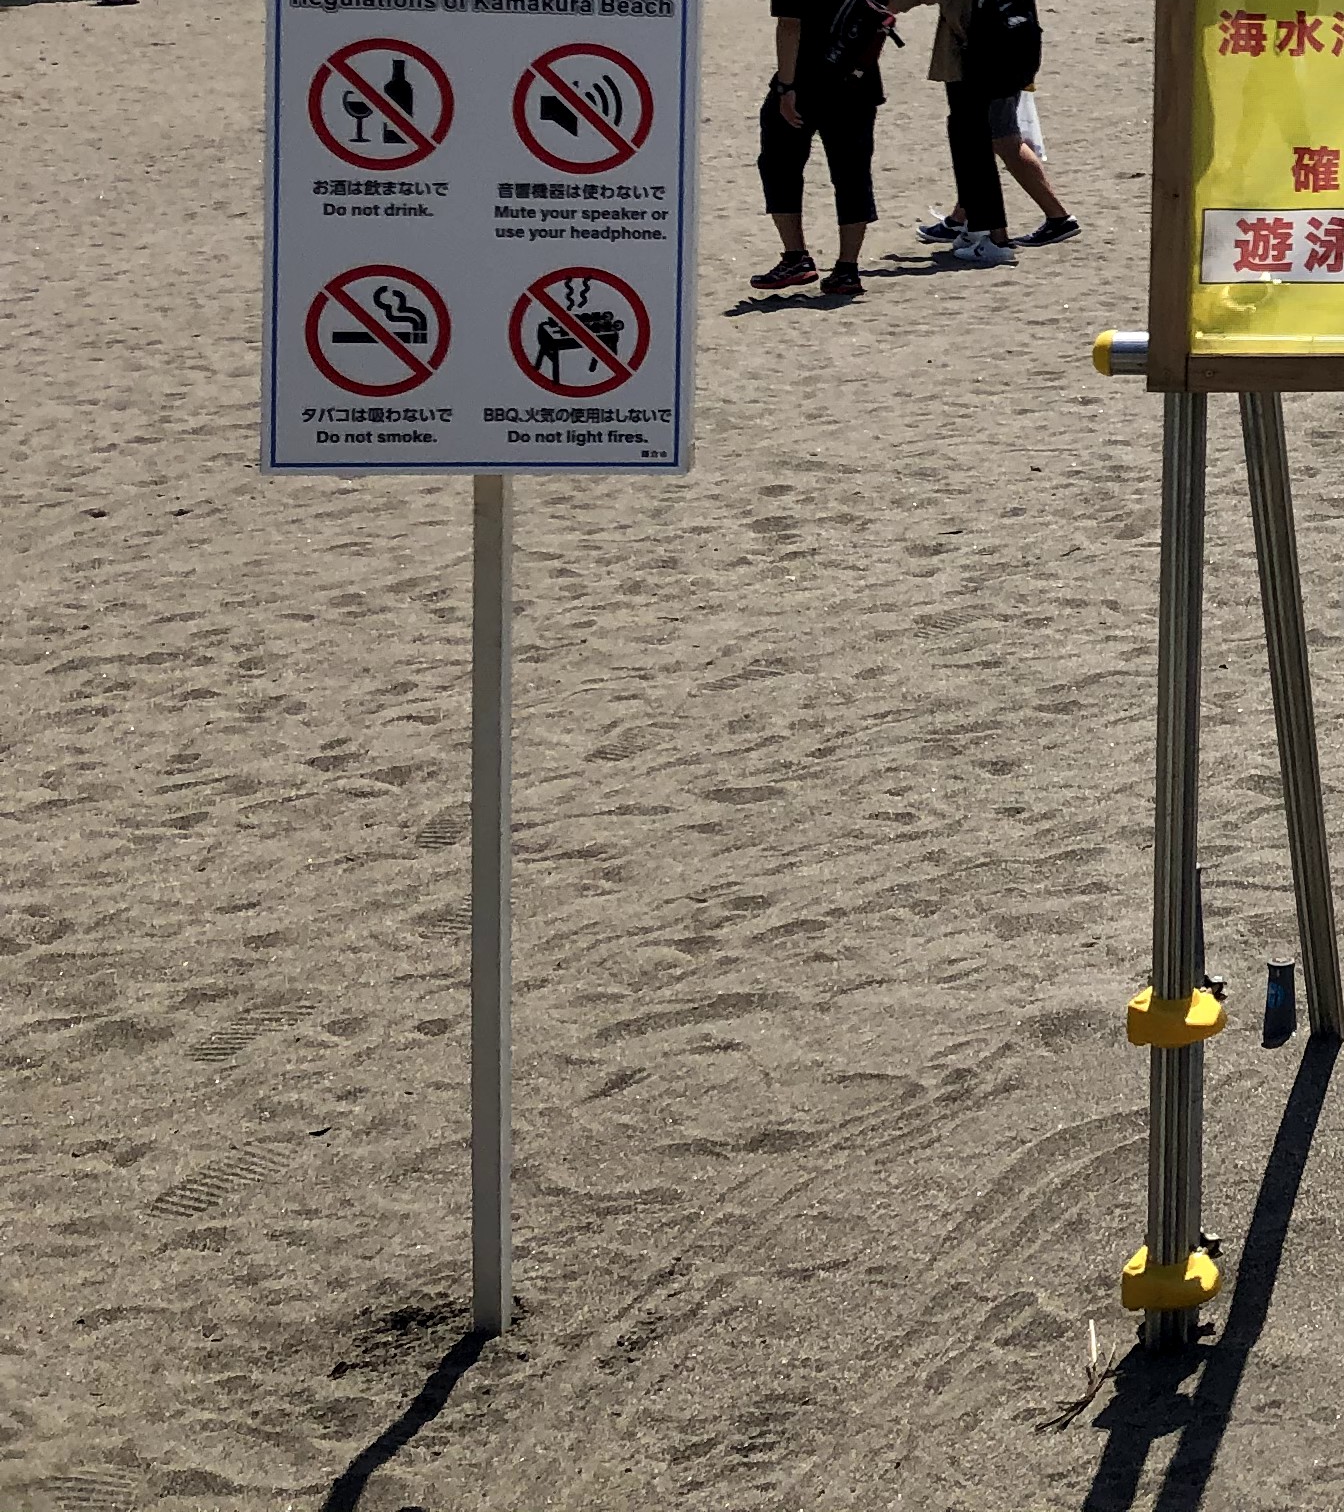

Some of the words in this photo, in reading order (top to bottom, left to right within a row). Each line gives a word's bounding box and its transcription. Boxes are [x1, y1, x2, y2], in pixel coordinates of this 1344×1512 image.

[312, 179, 449, 196] お酒は飲まないで
[322, 203, 348, 216] Do
[351, 203, 380, 216] not
[384, 203, 434, 217] drink.
[494, 205, 537, 219] Mute
[540, 207, 577, 221] your
[581, 205, 648, 221] speaker
[651, 208, 669, 221] or
[495, 226, 525, 239] use
[529, 228, 567, 242] your
[570, 226, 667, 242] headphone.
[300, 408, 453, 424] タバコは吸わないで
[316, 431, 341, 444] Do
[344, 431, 374, 444] not
[377, 431, 438, 444] smoke.
[507, 431, 531, 444] Do
[534, 431, 563, 444] not
[566, 430, 603, 446] light
[606, 431, 649, 445] fires.
